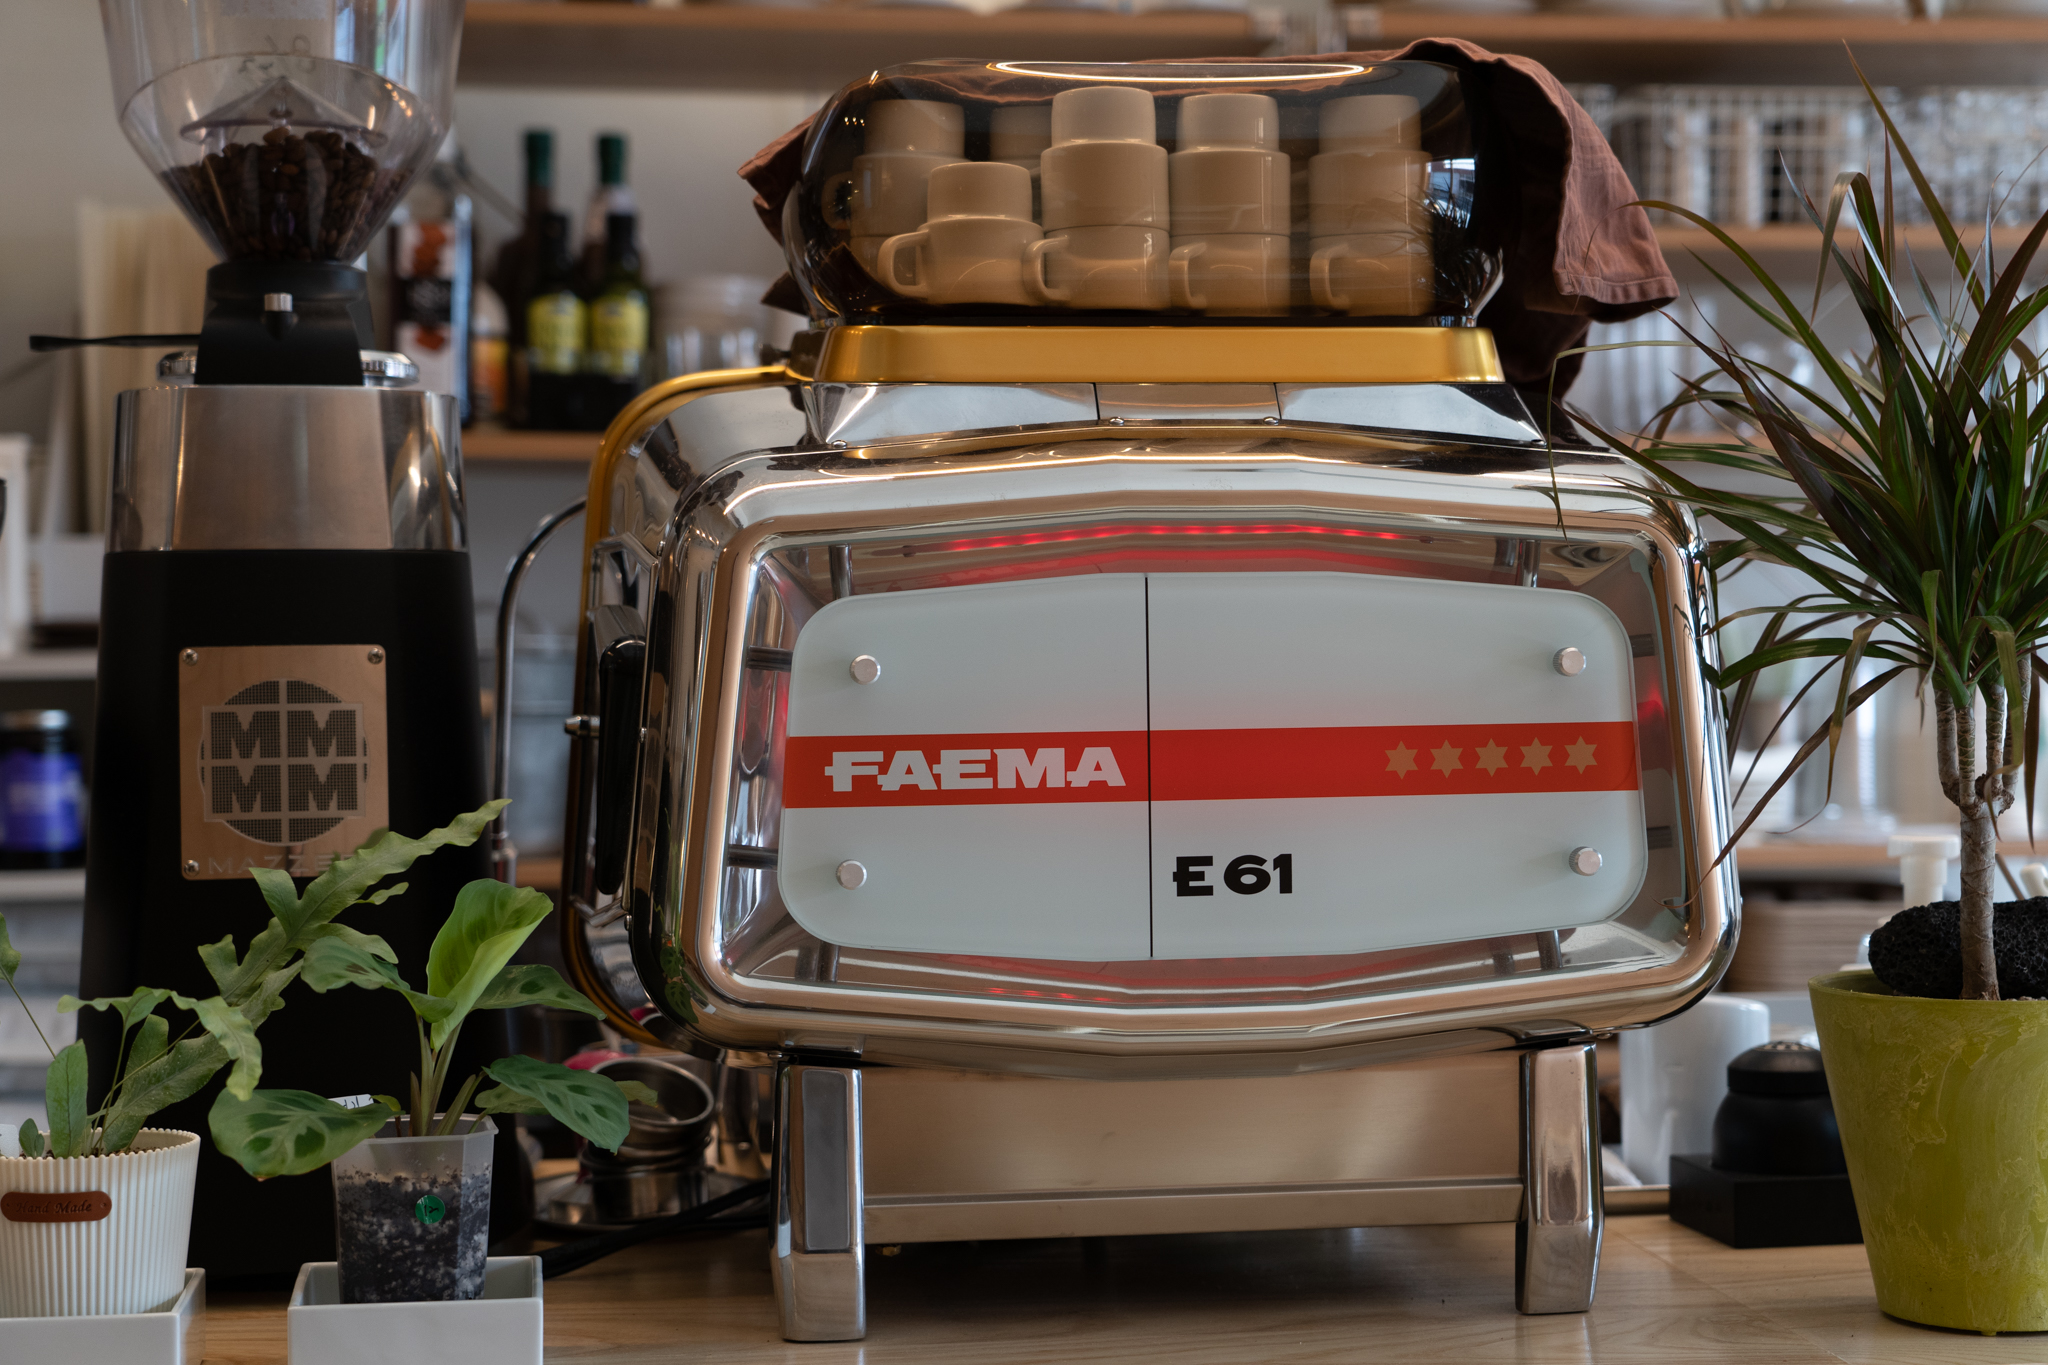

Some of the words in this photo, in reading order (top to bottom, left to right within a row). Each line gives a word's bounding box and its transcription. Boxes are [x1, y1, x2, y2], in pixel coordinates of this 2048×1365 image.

[825, 746, 1127, 792] FAEMA
[1172, 855, 1214, 897] E
[1223, 853, 1293, 895] 61
[54, 1200, 93, 1214] Made
